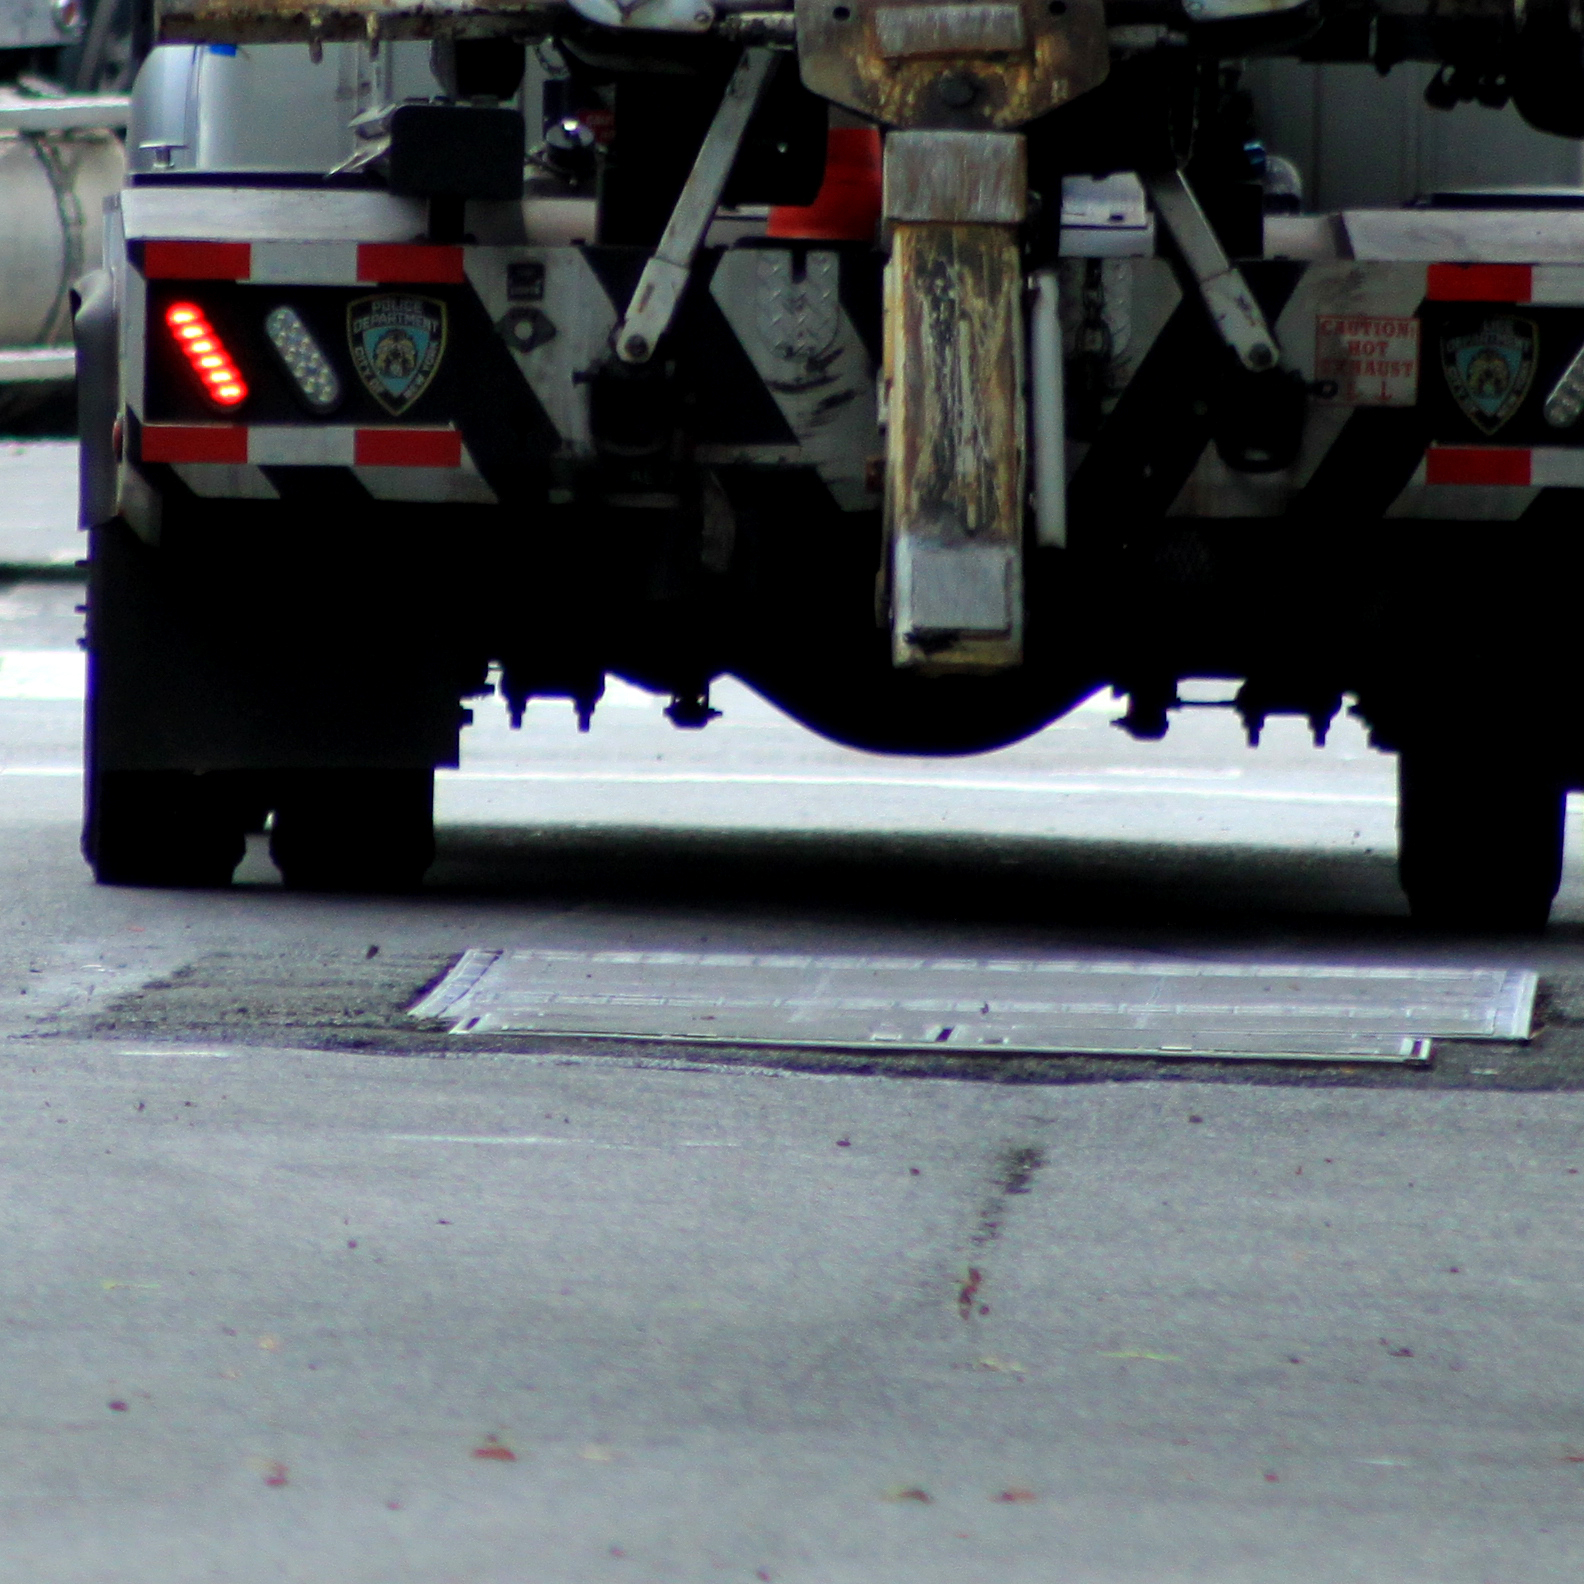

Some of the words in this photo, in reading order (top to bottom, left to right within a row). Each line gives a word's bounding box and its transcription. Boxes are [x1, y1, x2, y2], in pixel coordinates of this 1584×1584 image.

[371, 299, 423, 315] POLICE
[352, 311, 439, 334] DEPARTMENT
[1348, 340, 1389, 356] HOT
